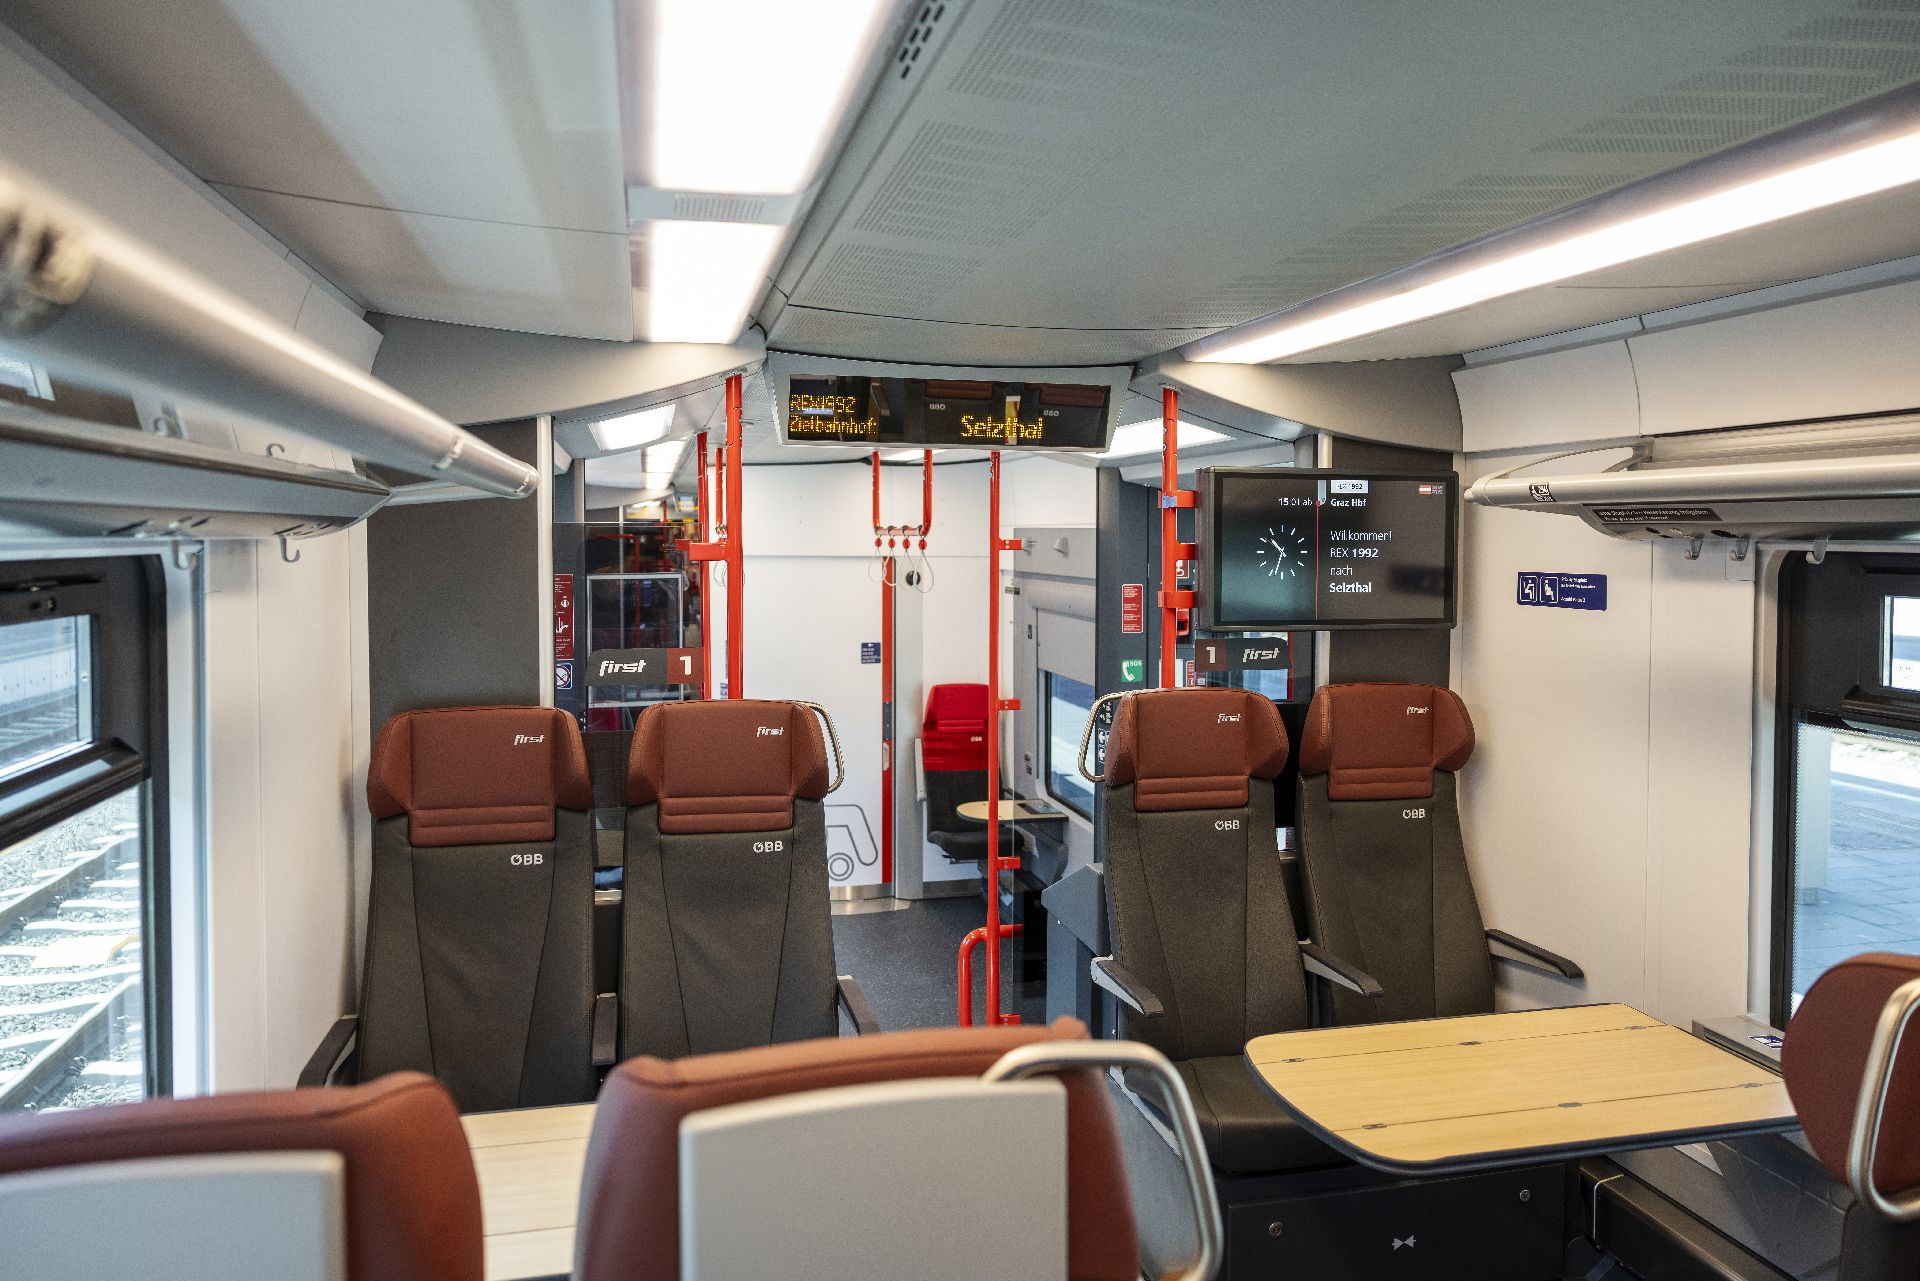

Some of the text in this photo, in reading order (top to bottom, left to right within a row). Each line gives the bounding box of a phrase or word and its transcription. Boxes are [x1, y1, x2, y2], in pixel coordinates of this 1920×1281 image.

[1278, 497, 1313, 506] 15:01 ab
[1330, 498, 1367, 507] Graz Hbf
[1330, 530, 1392, 541] Wilkommen!
[1330, 547, 1379, 558] REX 1992
[1330, 564, 1353, 576] nach
[1329, 582, 1372, 593] Selzthal
[1206, 646, 1216, 664] 1
[1242, 647, 1280, 663] first
[599, 659, 647, 677] first
[679, 655, 692, 676] 1
[1217, 713, 1242, 724] first
[756, 726, 785, 737] first
[513, 734, 546, 746] first
